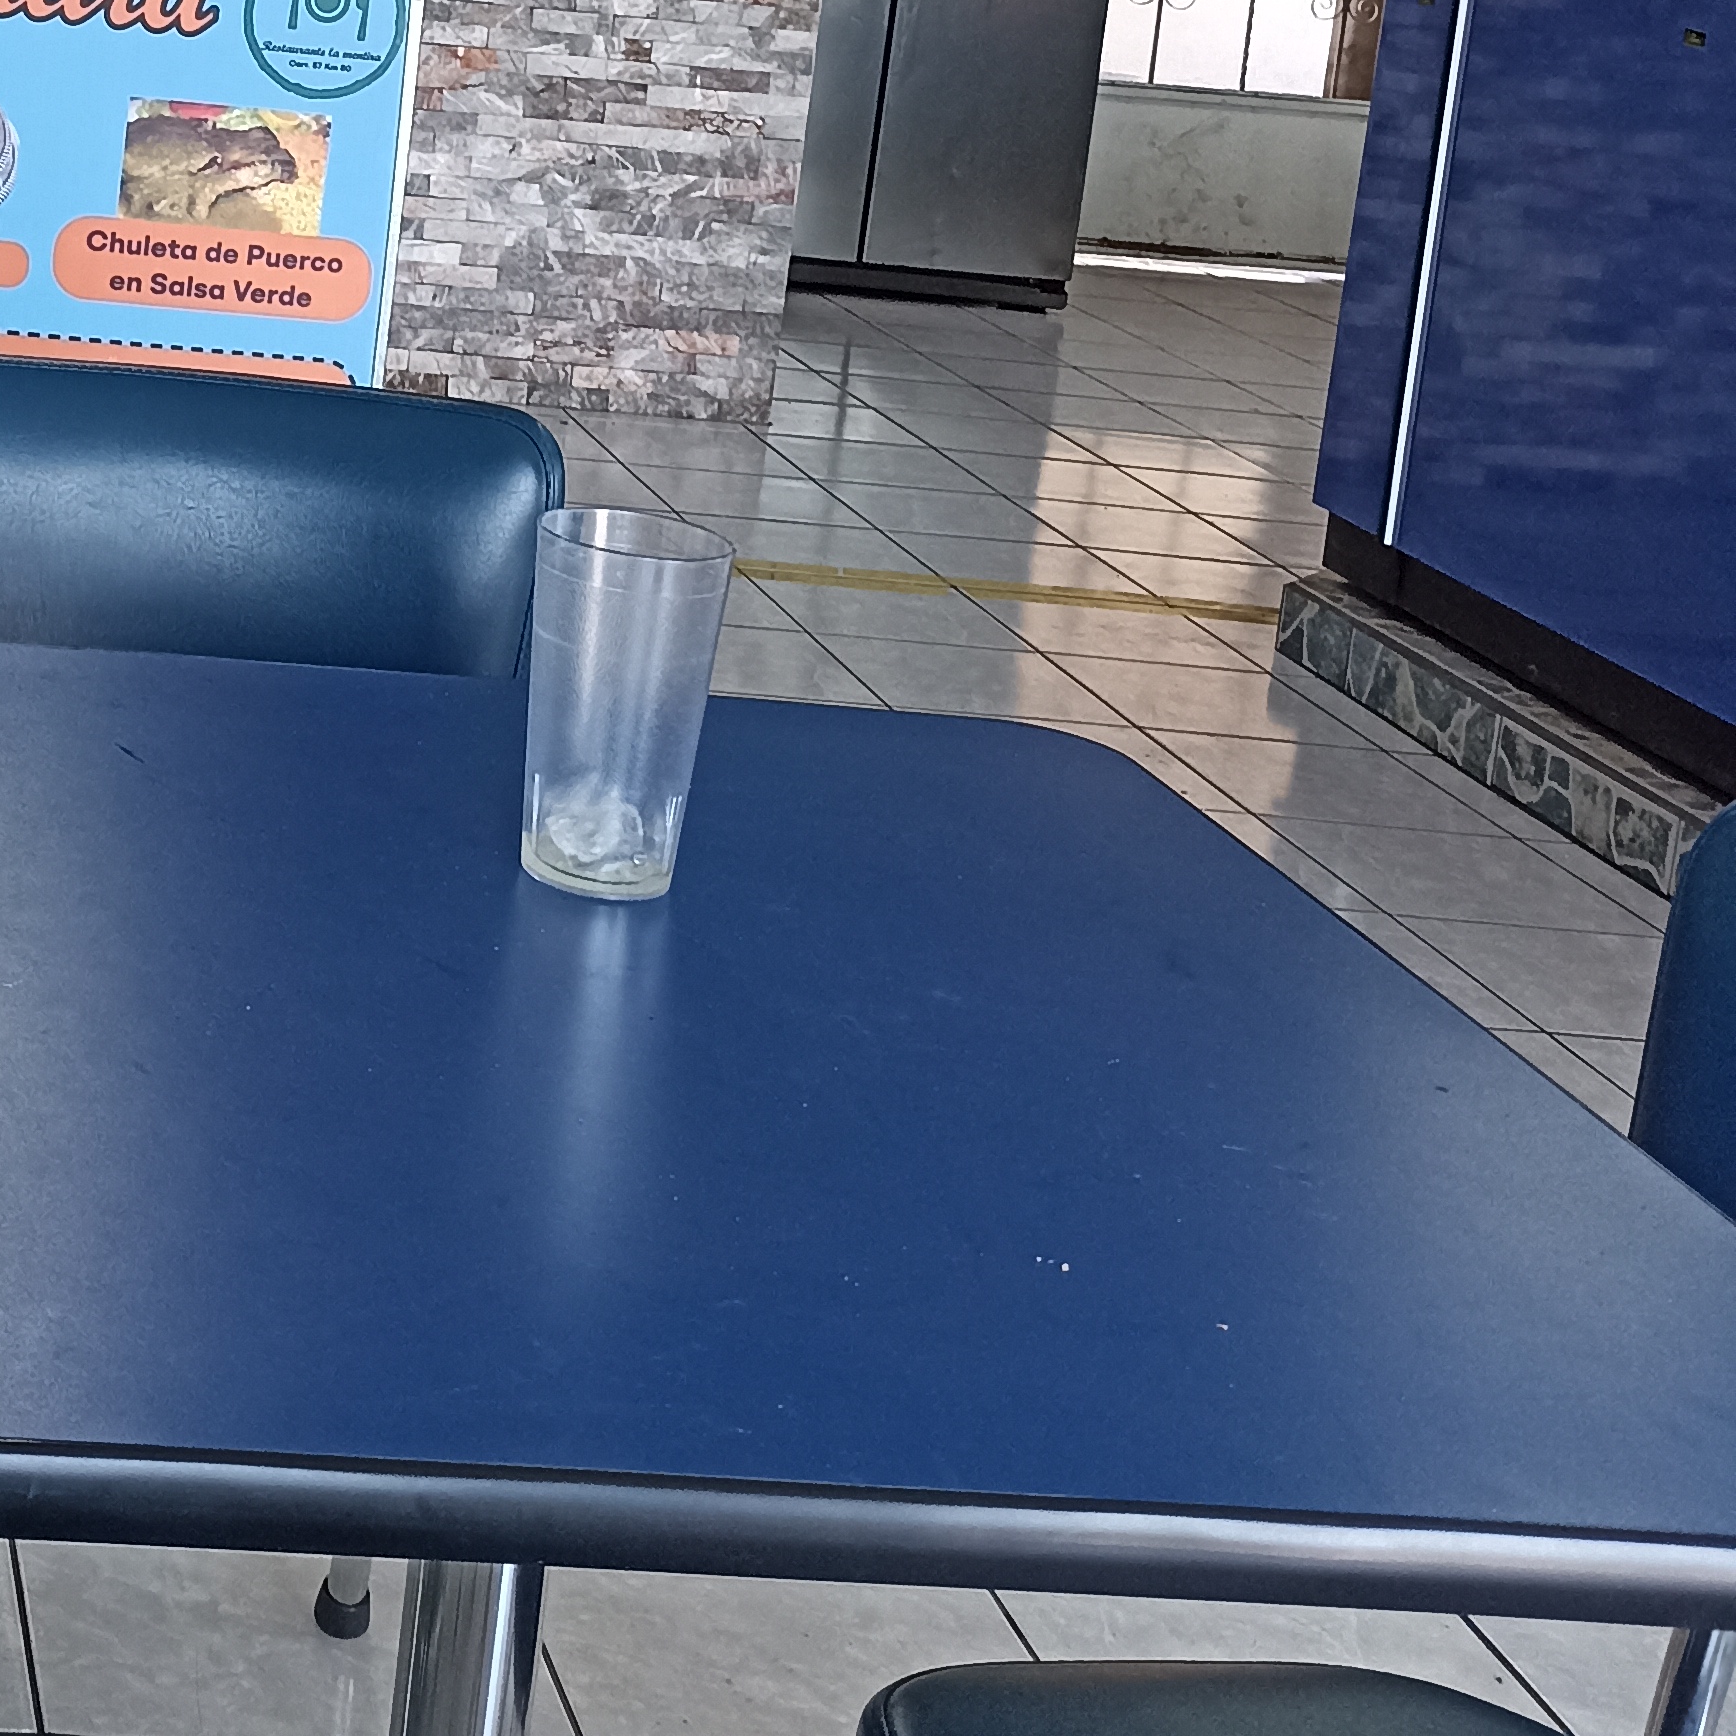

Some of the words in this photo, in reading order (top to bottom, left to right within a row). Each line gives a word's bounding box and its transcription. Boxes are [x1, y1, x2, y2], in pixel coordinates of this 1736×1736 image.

[260, 41, 325, 56] Restaurante
[328, 47, 339, 58] la
[86, 229, 197, 261] Chuleta
[205, 242, 238, 264] de
[246, 244, 343, 274] Puerco
[109, 274, 142, 293] en
[150, 272, 225, 300] Salsa
[233, 279, 312, 307] Verde
